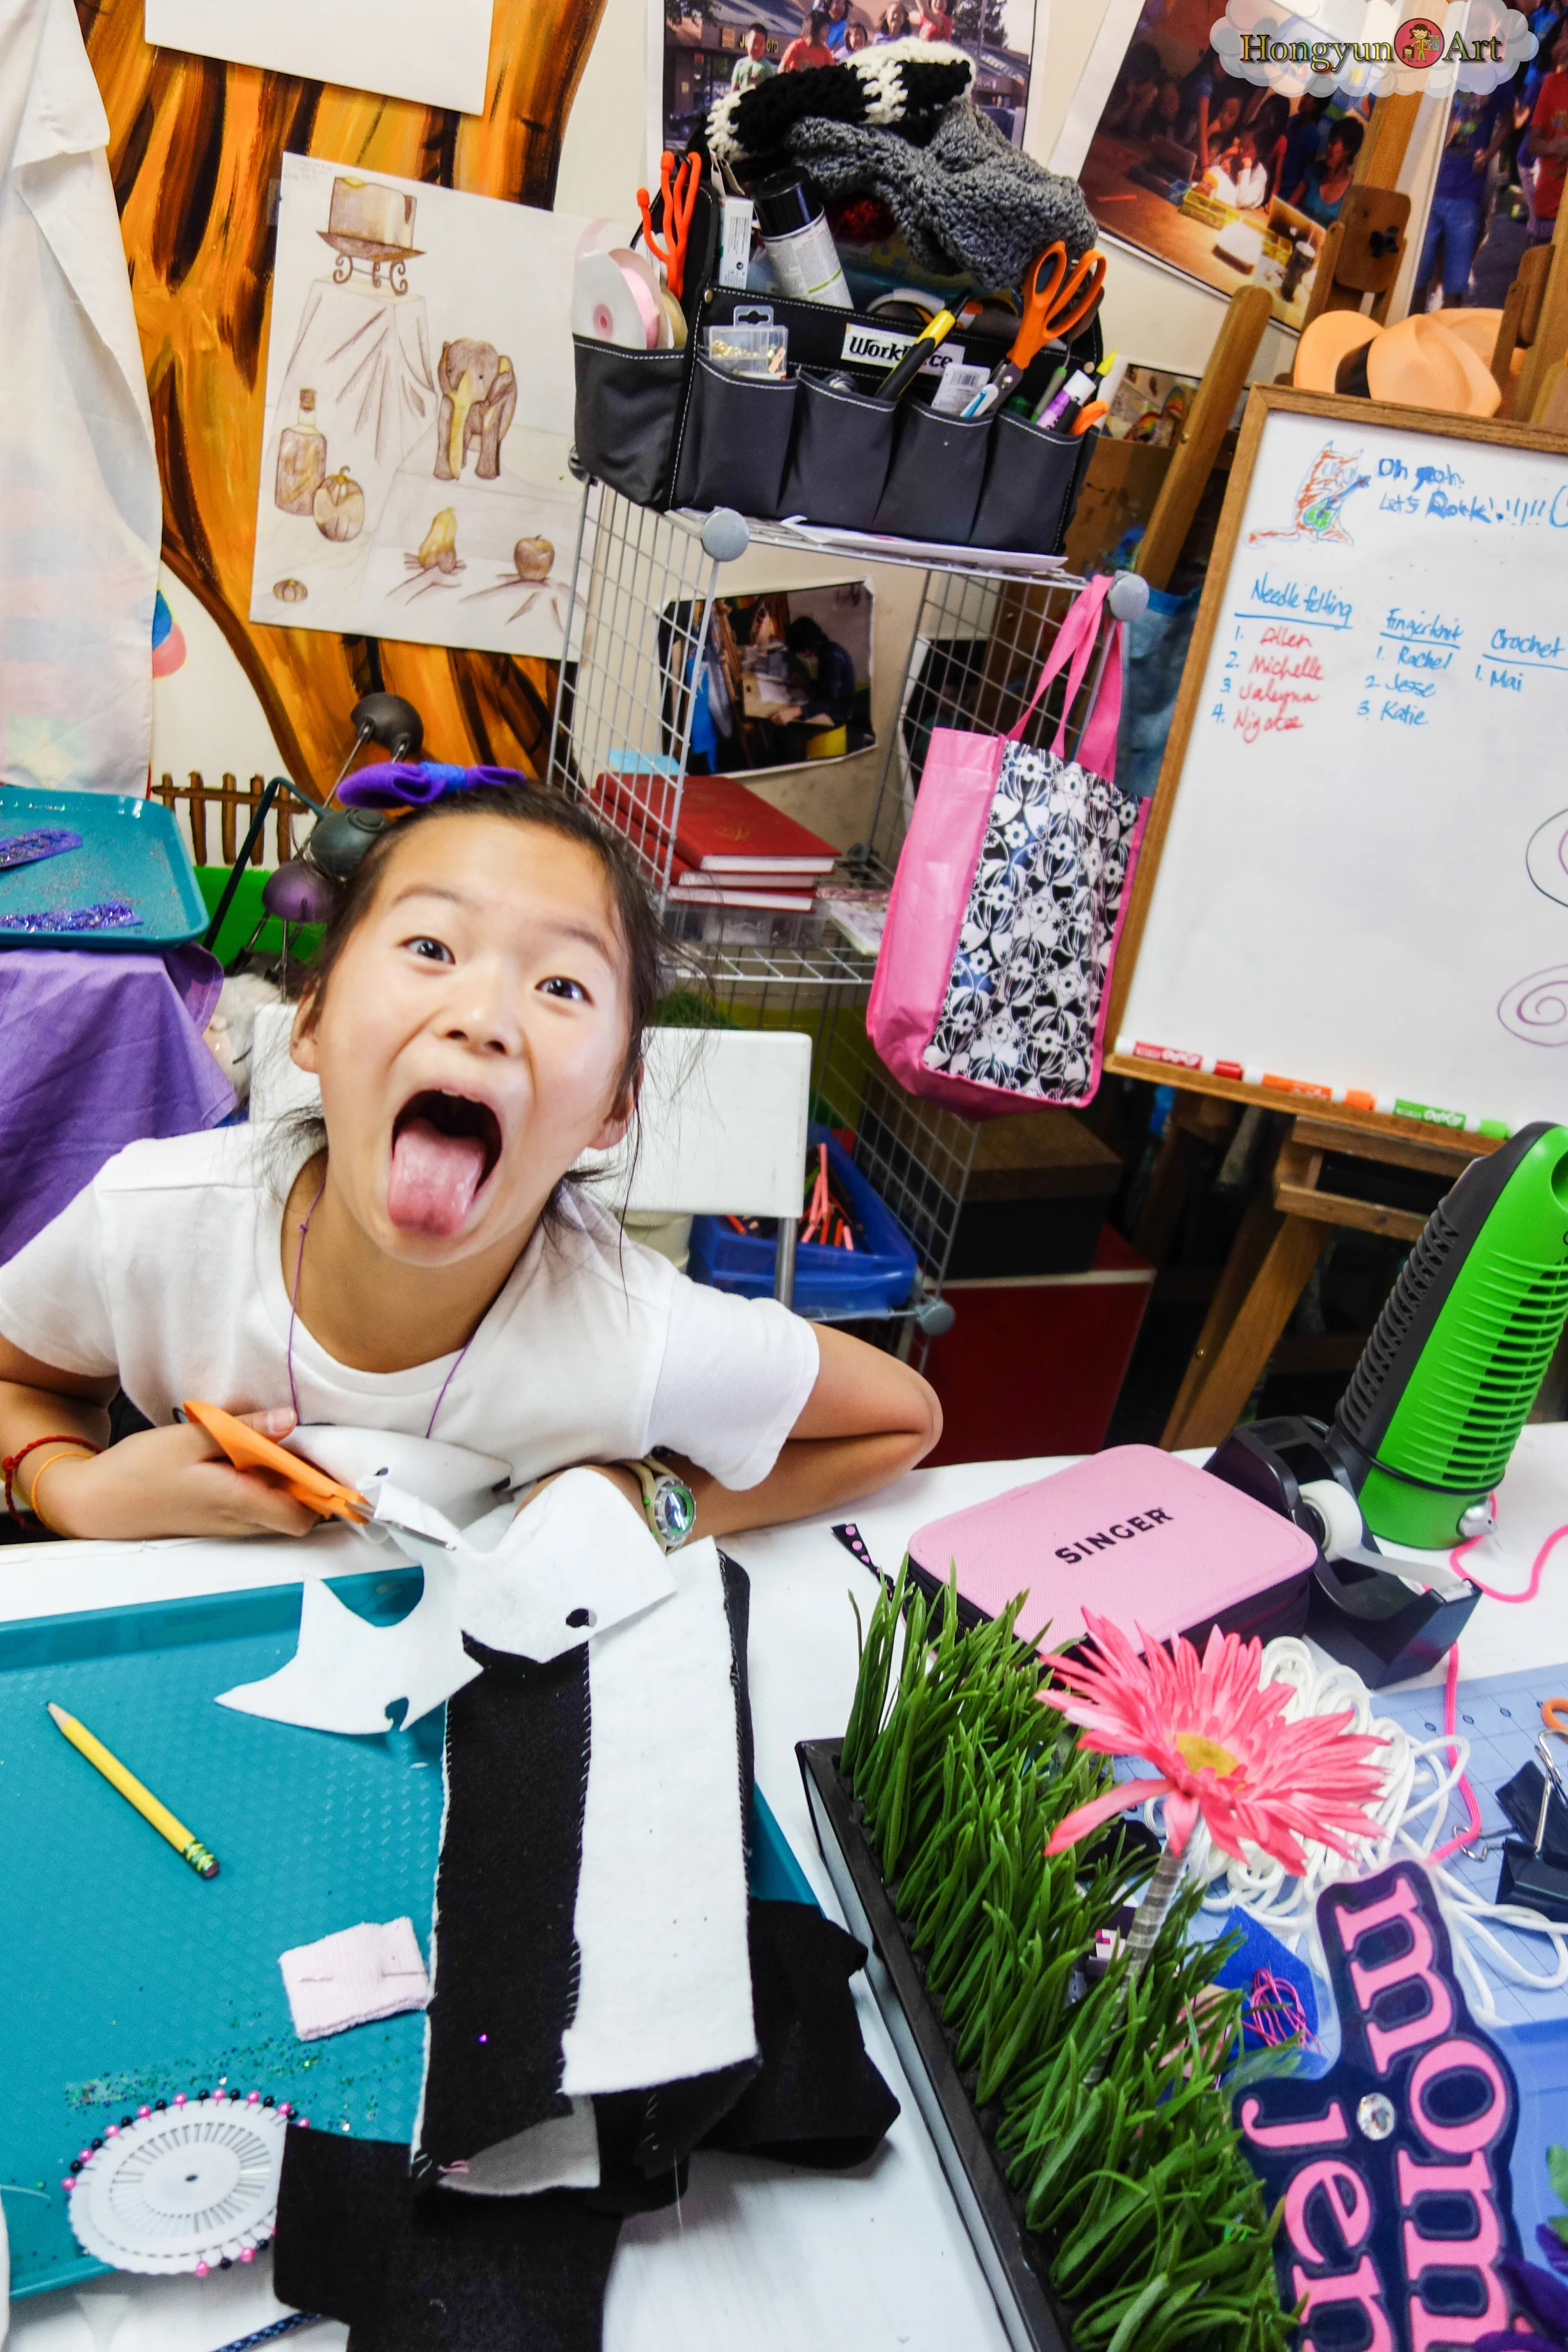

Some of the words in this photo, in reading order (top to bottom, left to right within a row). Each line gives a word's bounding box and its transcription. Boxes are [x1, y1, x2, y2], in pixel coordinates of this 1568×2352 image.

[849, 337, 954, 369] Workce
[1378, 458, 1408, 481] Oh
[1251, 571, 1300, 608] Needle
[1304, 586, 1352, 627] felting
[1491, 628, 1565, 659] Crochet
[1248, 654, 1324, 681] Michelle
[1397, 645, 1453, 670] Rachel
[1490, 669, 1524, 692] Mai
[1380, 701, 1429, 725] Katie
[1054, 1509, 1175, 1564] SINGER
